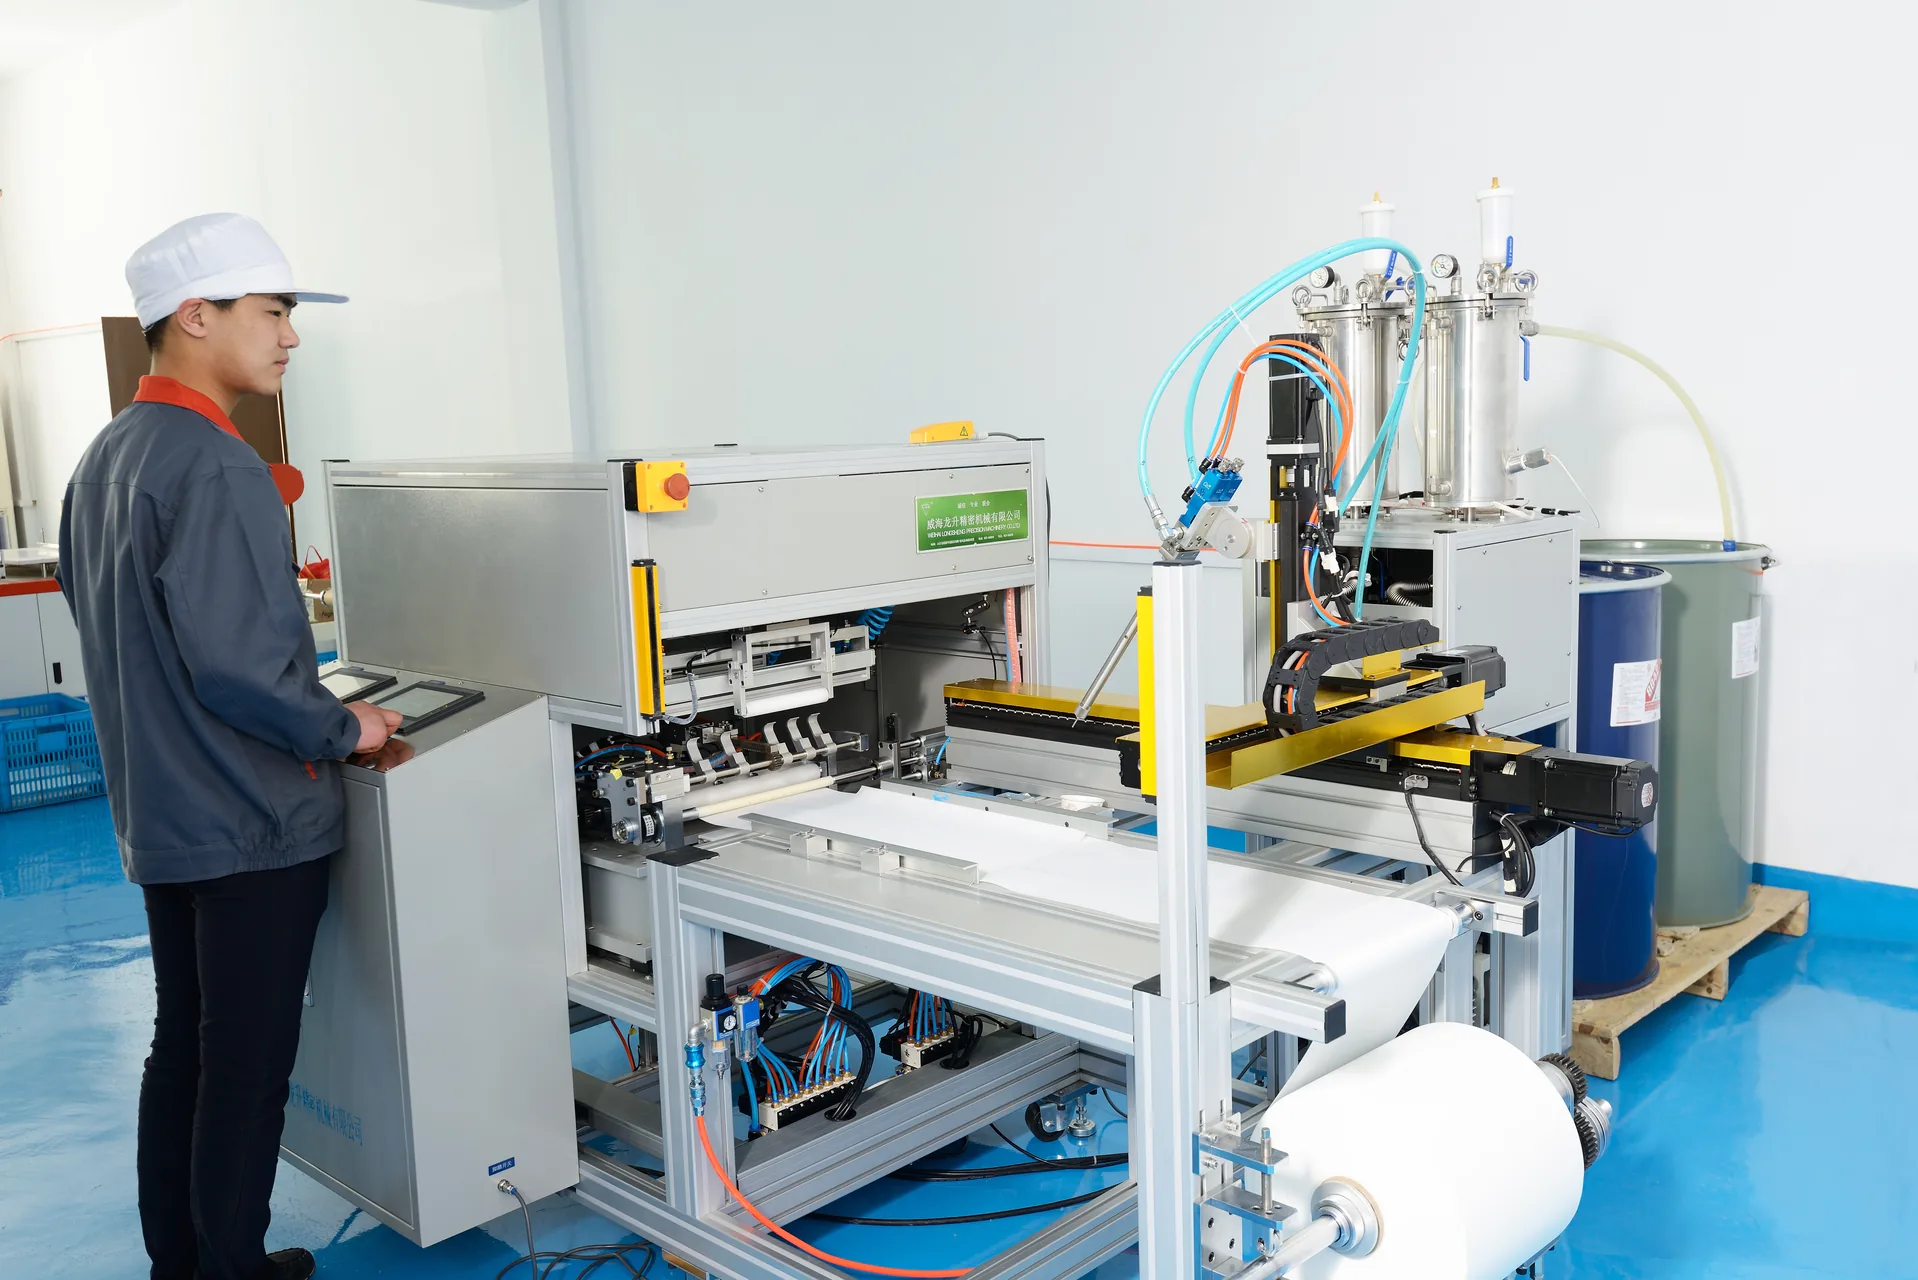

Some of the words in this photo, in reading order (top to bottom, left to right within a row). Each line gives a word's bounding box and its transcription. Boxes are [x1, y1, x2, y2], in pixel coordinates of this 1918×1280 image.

[927, 510, 1020, 530] 威海龙升精密机械有限公司
